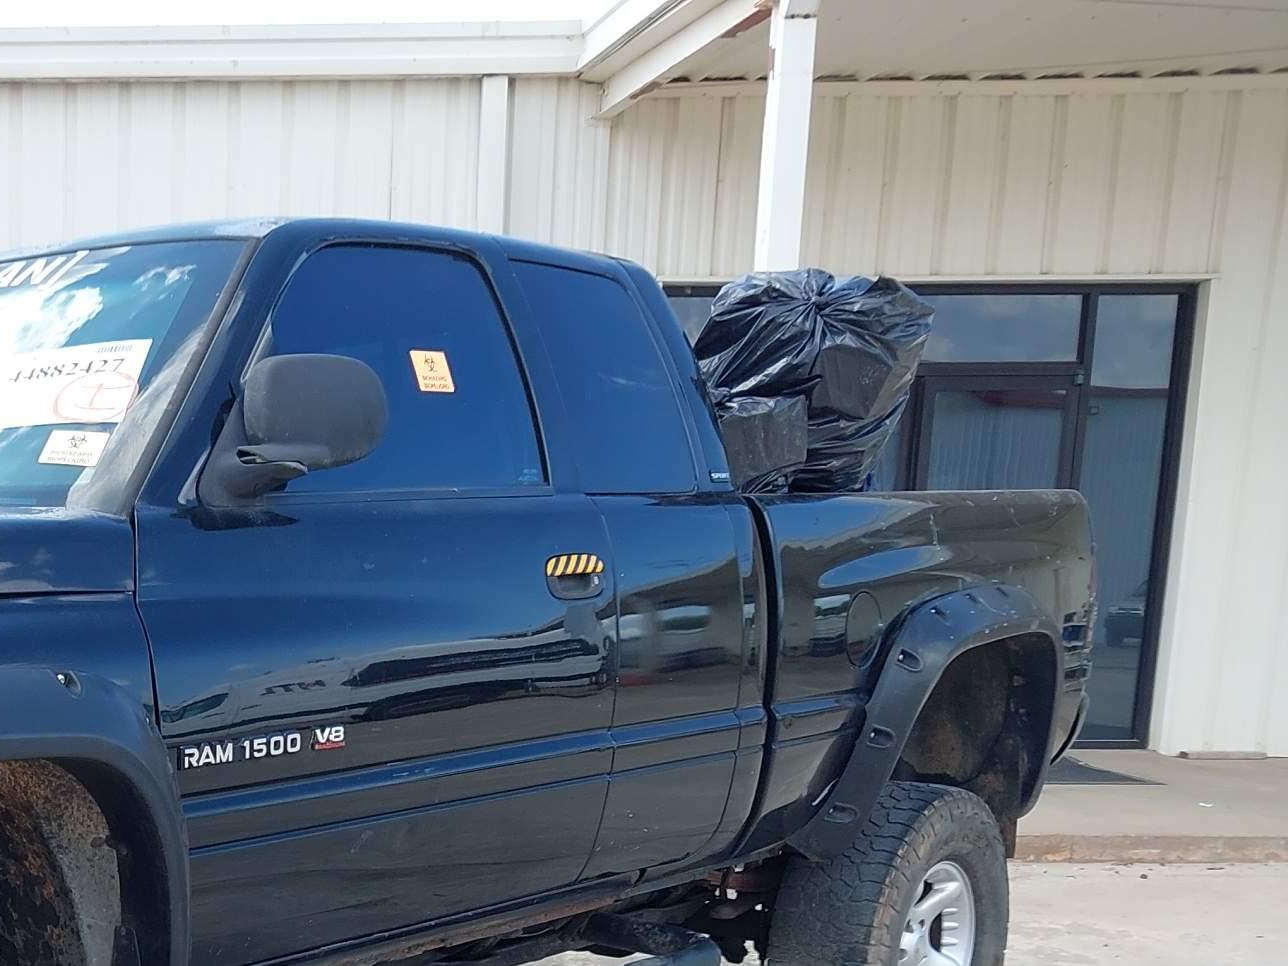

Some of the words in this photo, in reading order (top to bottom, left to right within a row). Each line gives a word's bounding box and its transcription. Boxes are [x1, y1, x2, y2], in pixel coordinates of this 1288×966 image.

[8, 357, 126, 384] 44882427
[183, 742, 234, 769] RAM
[242, 732, 302, 760] 1500
[315, 726, 346, 743] V8
